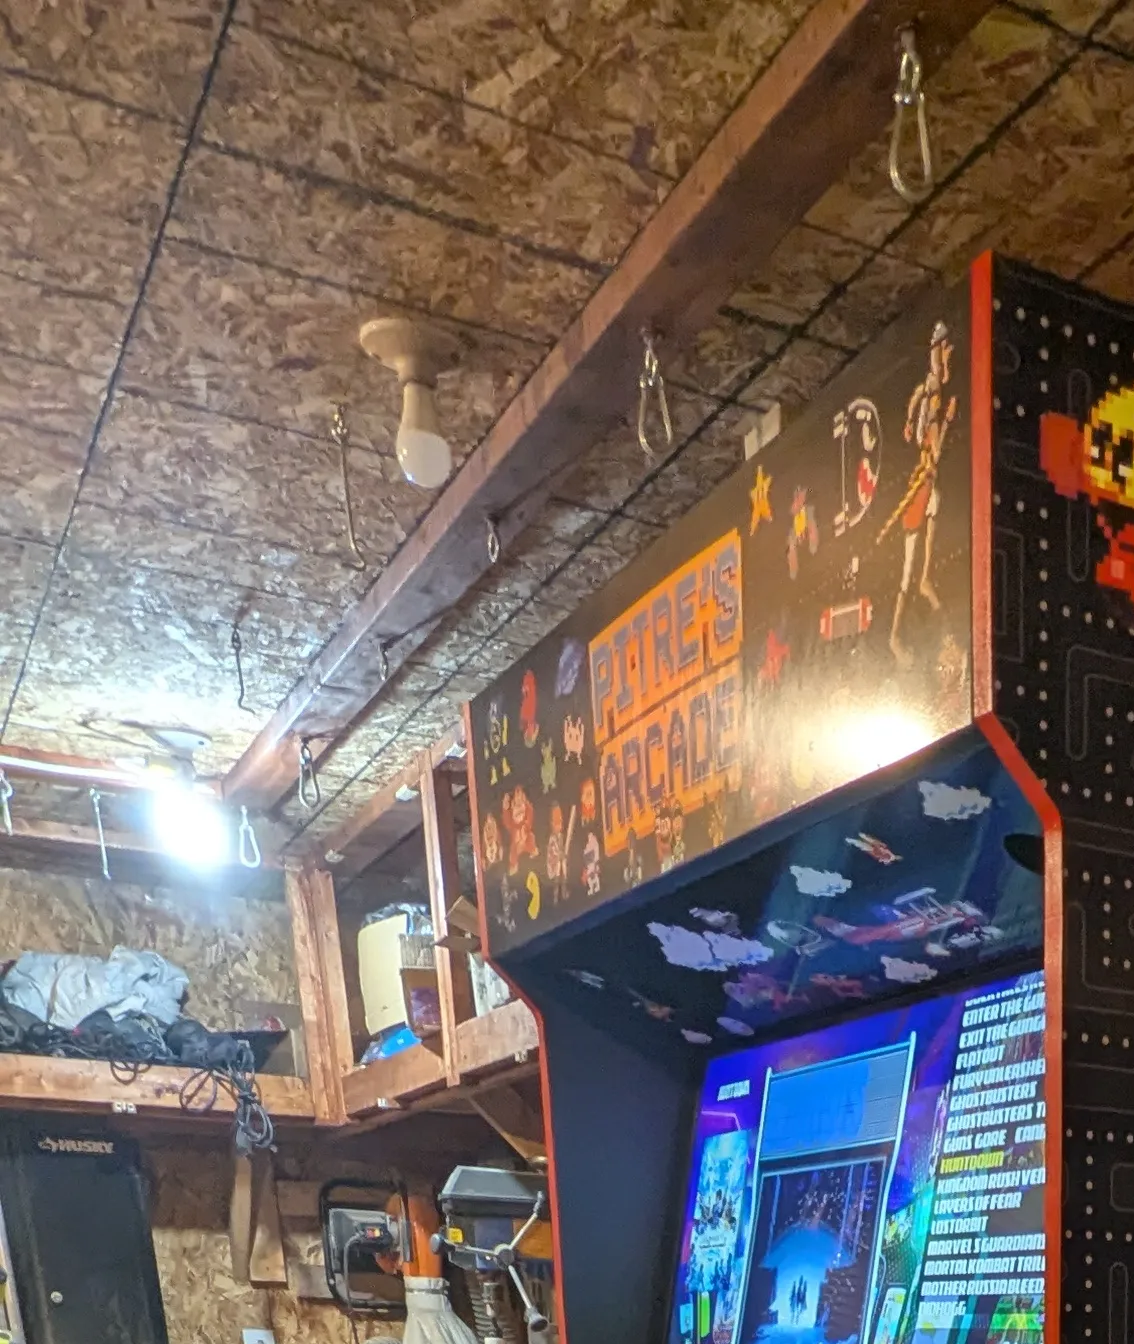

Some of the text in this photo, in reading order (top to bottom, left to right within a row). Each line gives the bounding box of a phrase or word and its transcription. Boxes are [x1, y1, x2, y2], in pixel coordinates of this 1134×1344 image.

[591, 544, 740, 729] PITRE'S
[602, 673, 742, 835] ARCADE
[962, 1002, 1000, 1028] ENTER
[1000, 997, 1024, 1021] THE
[959, 1027, 986, 1049] EXIT
[985, 1022, 1010, 1044] THE
[949, 1081, 1038, 1112] GHOSTBUSTERS
[946, 1104, 1034, 1133] GHOSTBUSTERS
[57, 1138, 115, 1154] HUSKY
[943, 1134, 973, 1154] GUNS
[974, 1129, 1008, 1150] GORE
[939, 1150, 1005, 1175] HUNTDOWN
[936, 1174, 989, 1195] KINGDOM
[988, 1170, 1021, 1190] RUSH
[933, 1191, 1023, 1215] LAYERS OF FEAR
[930, 1215, 989, 1236] LOST ORBIT
[923, 1258, 968, 1277] MORTAL
[967, 1256, 1017, 1275] KOMBAT
[920, 1280, 968, 1297] MOTHER
[966, 1278, 1008, 1296] RUSSIA
